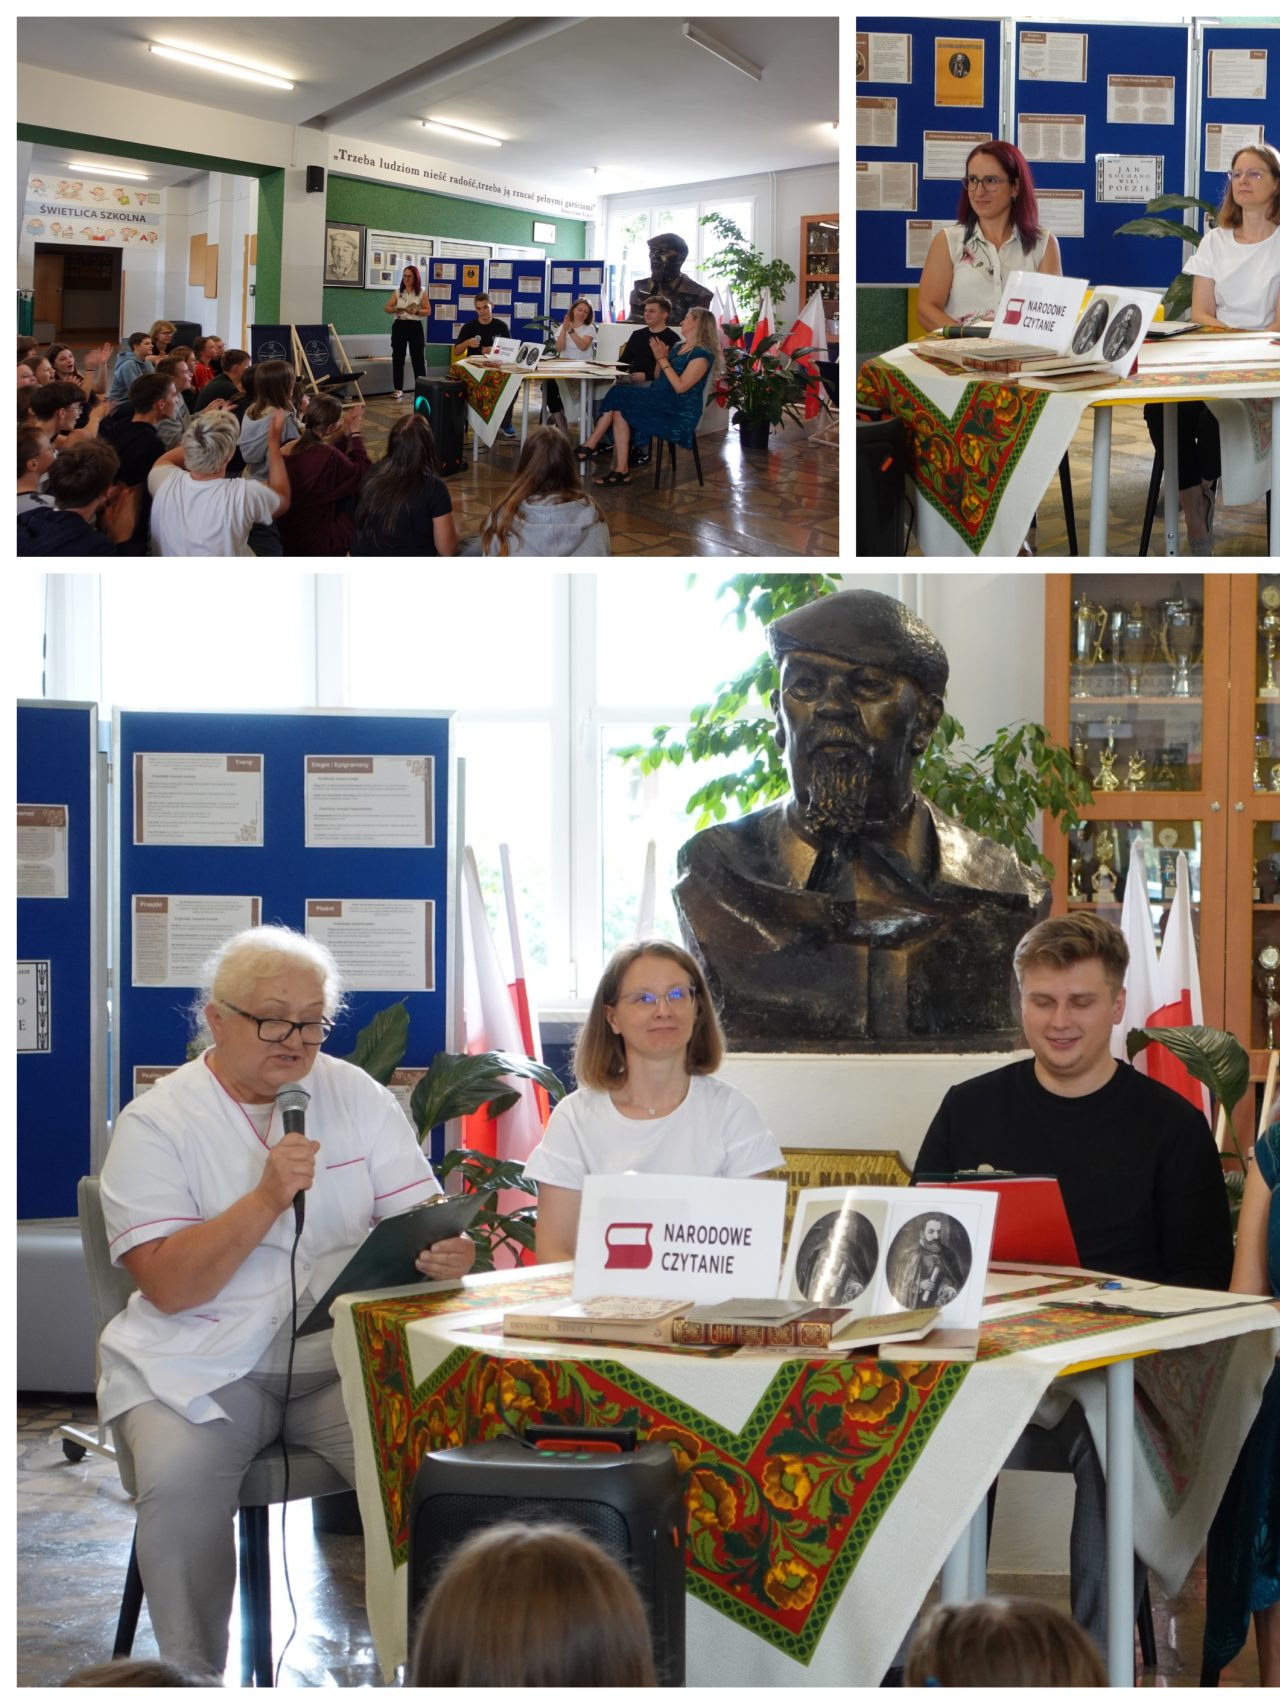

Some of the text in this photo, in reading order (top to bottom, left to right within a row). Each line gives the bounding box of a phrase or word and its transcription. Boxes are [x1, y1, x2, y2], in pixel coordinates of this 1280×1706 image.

[379, 158, 420, 176] ludziom
[423, 170, 447, 182] nieść
[1118, 166, 1141, 174] JAN
[40, 204, 146, 223] ŚWIETLICA SZKOLNA
[1026, 300, 1067, 318] NARODOWE
[1022, 315, 1057, 333] CZYTANIE
[664, 1223, 752, 1246] NARODOWE
[661, 1252, 735, 1274] CZYTANIE
